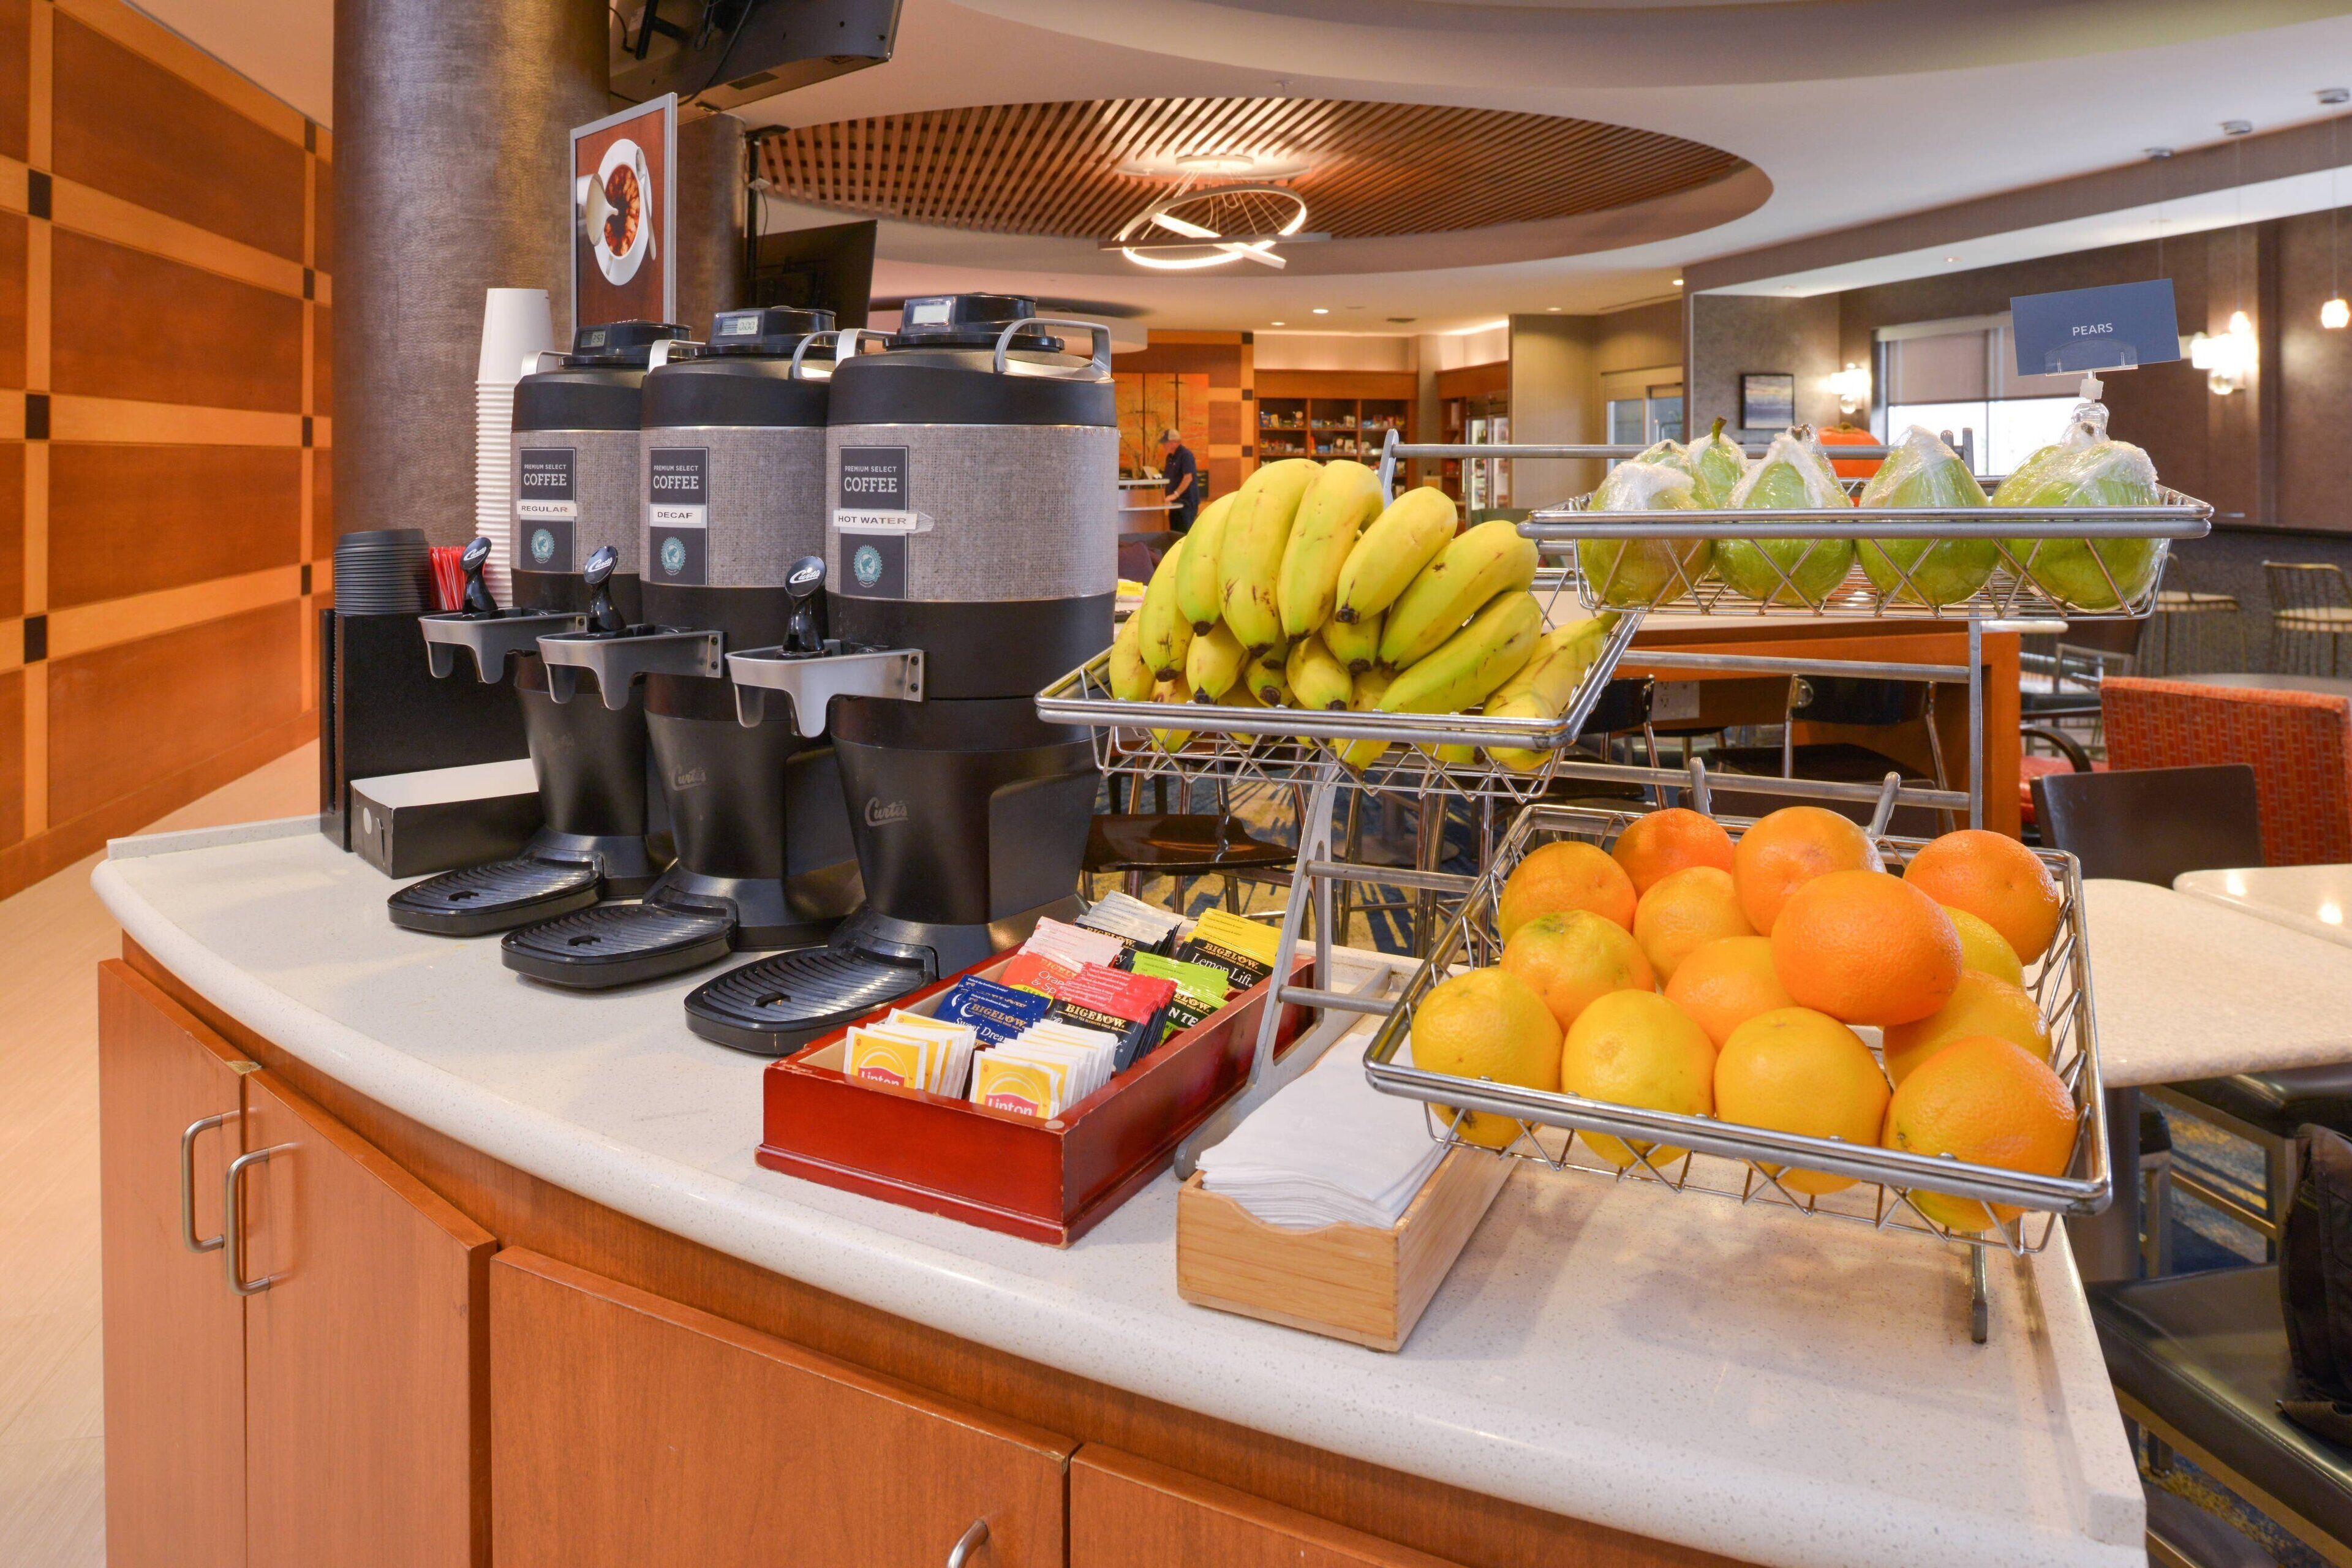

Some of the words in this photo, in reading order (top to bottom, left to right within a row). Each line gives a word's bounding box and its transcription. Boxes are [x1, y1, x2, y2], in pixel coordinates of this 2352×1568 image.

[2072, 323, 2114, 336] PEARS
[524, 473, 567, 486] COFFEE
[653, 475, 699, 489] COFFEE
[844, 477, 897, 492] COFFEE
[790, 569, 821, 584] Curtis
[865, 797, 908, 827] Curtis
[1204, 943, 1259, 968] BIGELOW
[1038, 971, 1065, 986] Oran
[1174, 993, 1212, 1011] ELOW
[971, 1004, 1028, 1028] BIGELOW
[1065, 1003, 1126, 1027] BIGELOW
[1181, 1012, 1199, 1027] TE
[980, 1027, 1005, 1042] Drea
